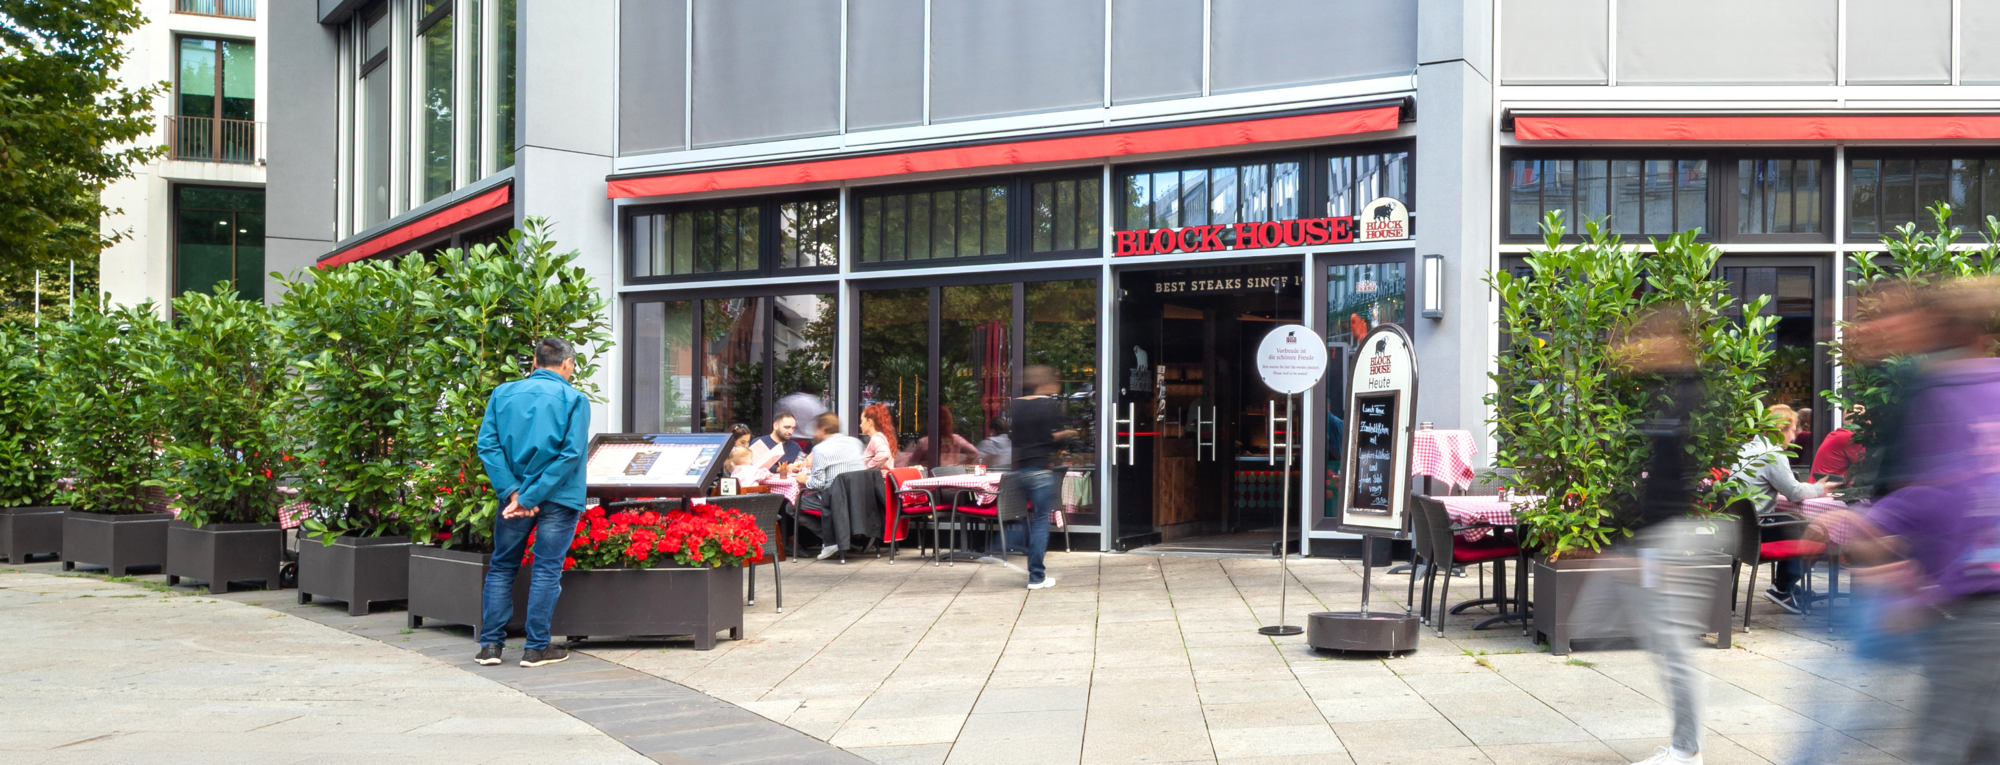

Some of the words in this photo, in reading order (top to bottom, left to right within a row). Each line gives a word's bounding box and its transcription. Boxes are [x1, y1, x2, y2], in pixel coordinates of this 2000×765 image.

[1366, 220, 1403, 231] BLOCK
[1115, 225, 1226, 257] BLOCK
[1233, 216, 1353, 250] HOUSE
[1366, 229, 1403, 239] HOUSE
[1155, 282, 1186, 293] BEST
[1191, 279, 1241, 291] STEAKS
[1247, 276, 1289, 288] SINCE
[1370, 355, 1391, 366] BLOCK
[1370, 365, 1391, 375] HOUSE
[1368, 377, 1390, 389] Heute
